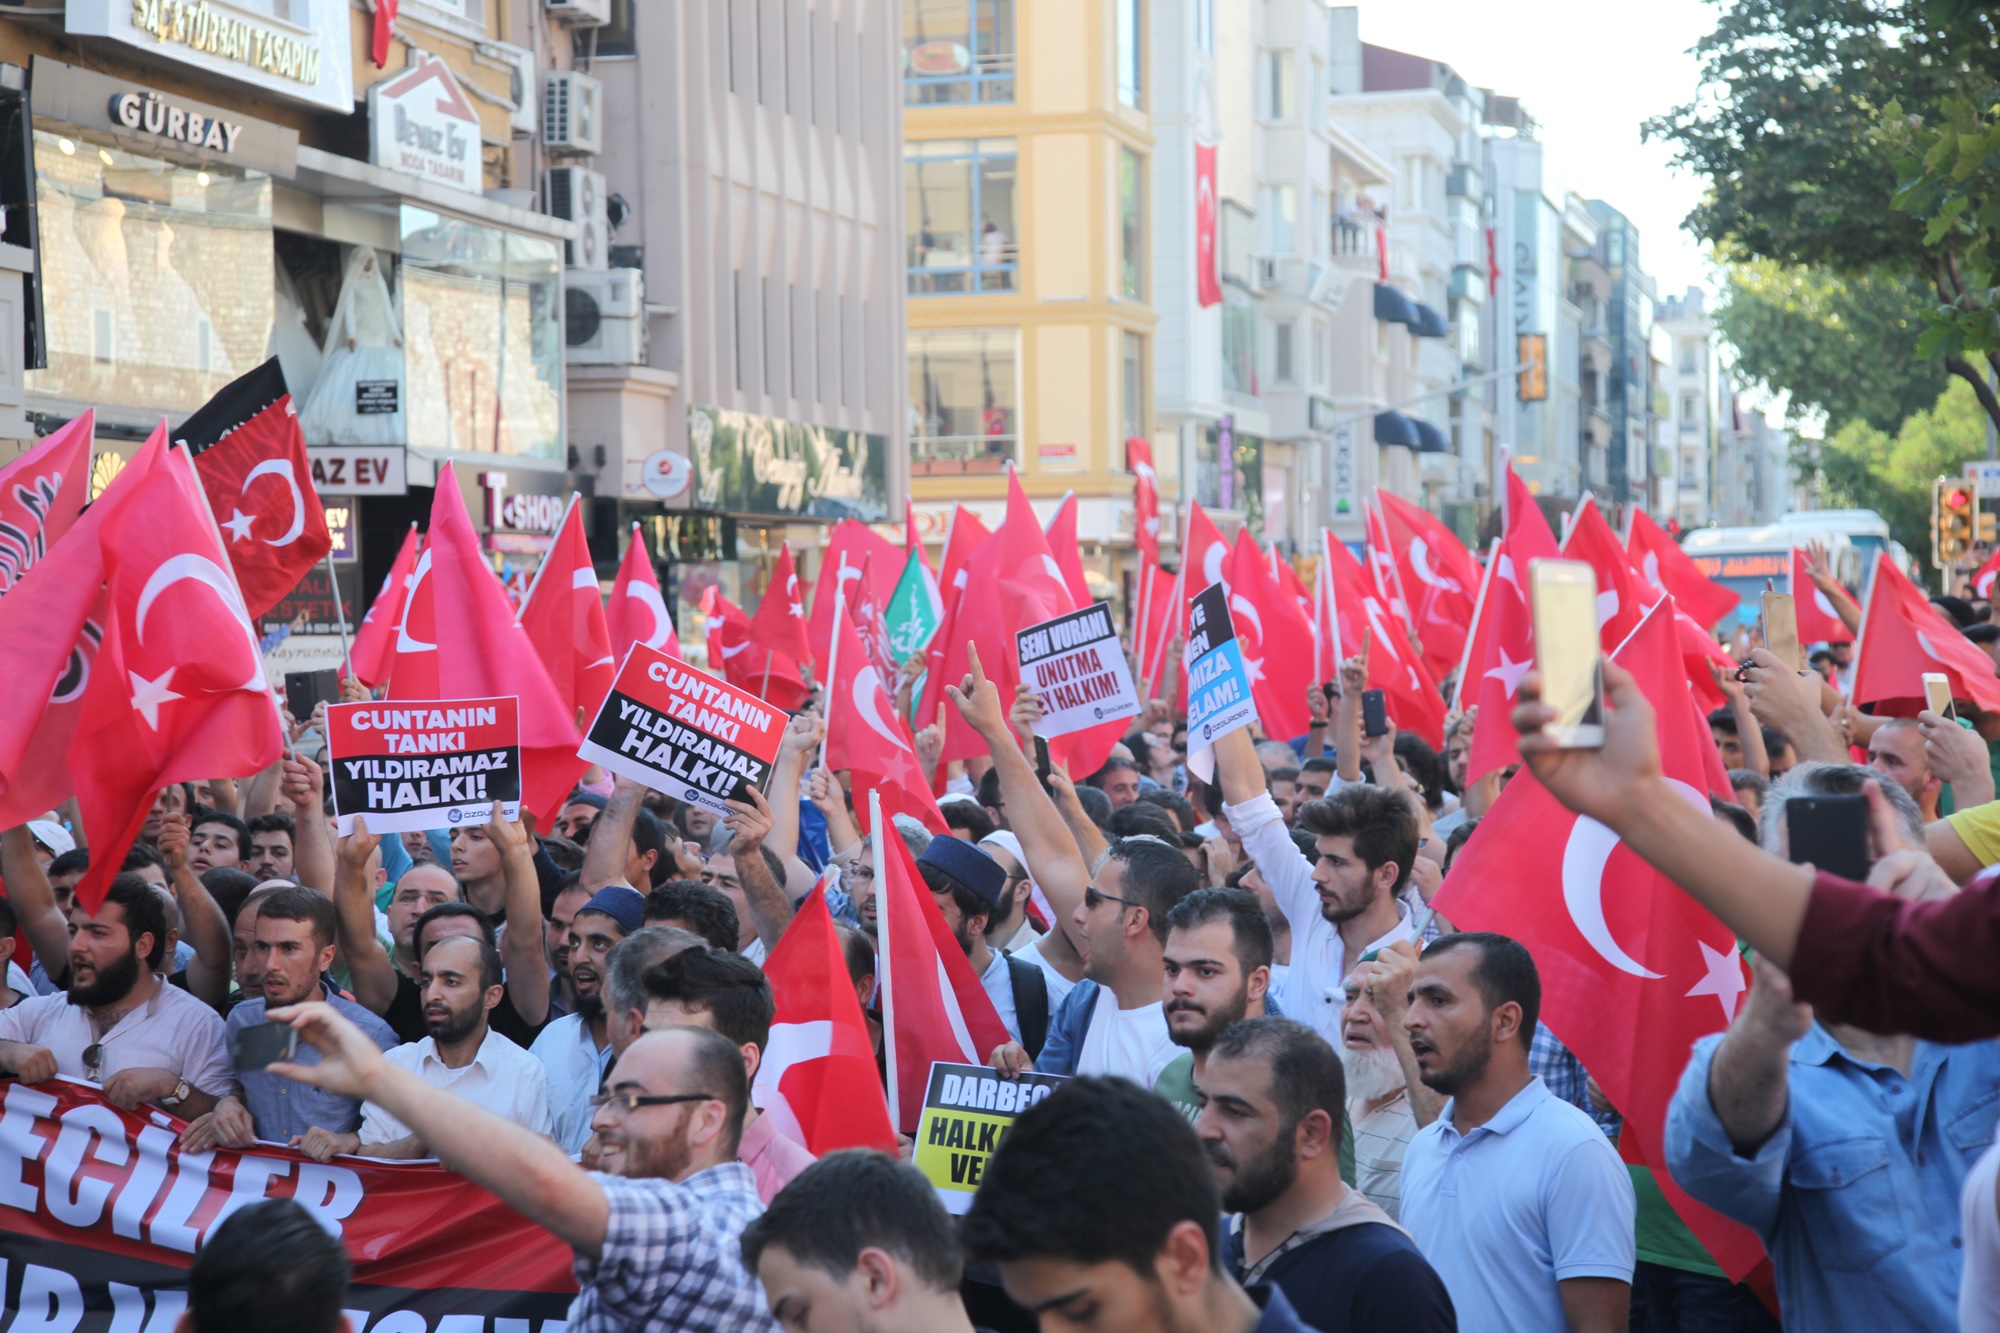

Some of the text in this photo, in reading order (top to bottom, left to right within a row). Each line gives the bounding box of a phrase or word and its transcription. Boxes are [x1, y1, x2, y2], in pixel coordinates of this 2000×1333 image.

[117, 92, 243, 153] GÜRBAY
[310, 458, 389, 485] AZ EV
[513, 493, 564, 531] SHOP
[1049, 610, 1110, 652] VURANI
[1189, 603, 1207, 632] YE
[1036, 648, 1103, 688] UNUTMA
[648, 662, 772, 733] CUNTANIN
[1053, 671, 1121, 711] HALKIM!
[351, 706, 497, 731] CUNTANIN
[667, 694, 741, 743] TANKI
[1212, 708, 1250, 733] ÖZGÜRDER
[384, 732, 466, 754] TANKI
[619, 699, 763, 783] YILDIRAMAZ
[344, 751, 508, 780] YILDIRAMAZ
[620, 728, 739, 797] HALKI!
[367, 774, 487, 809] HALKI!
[464, 808, 515, 820] ÖZGÜER
[940, 1074, 1061, 1114] DARBEC
[951, 1153, 991, 1186] VE
